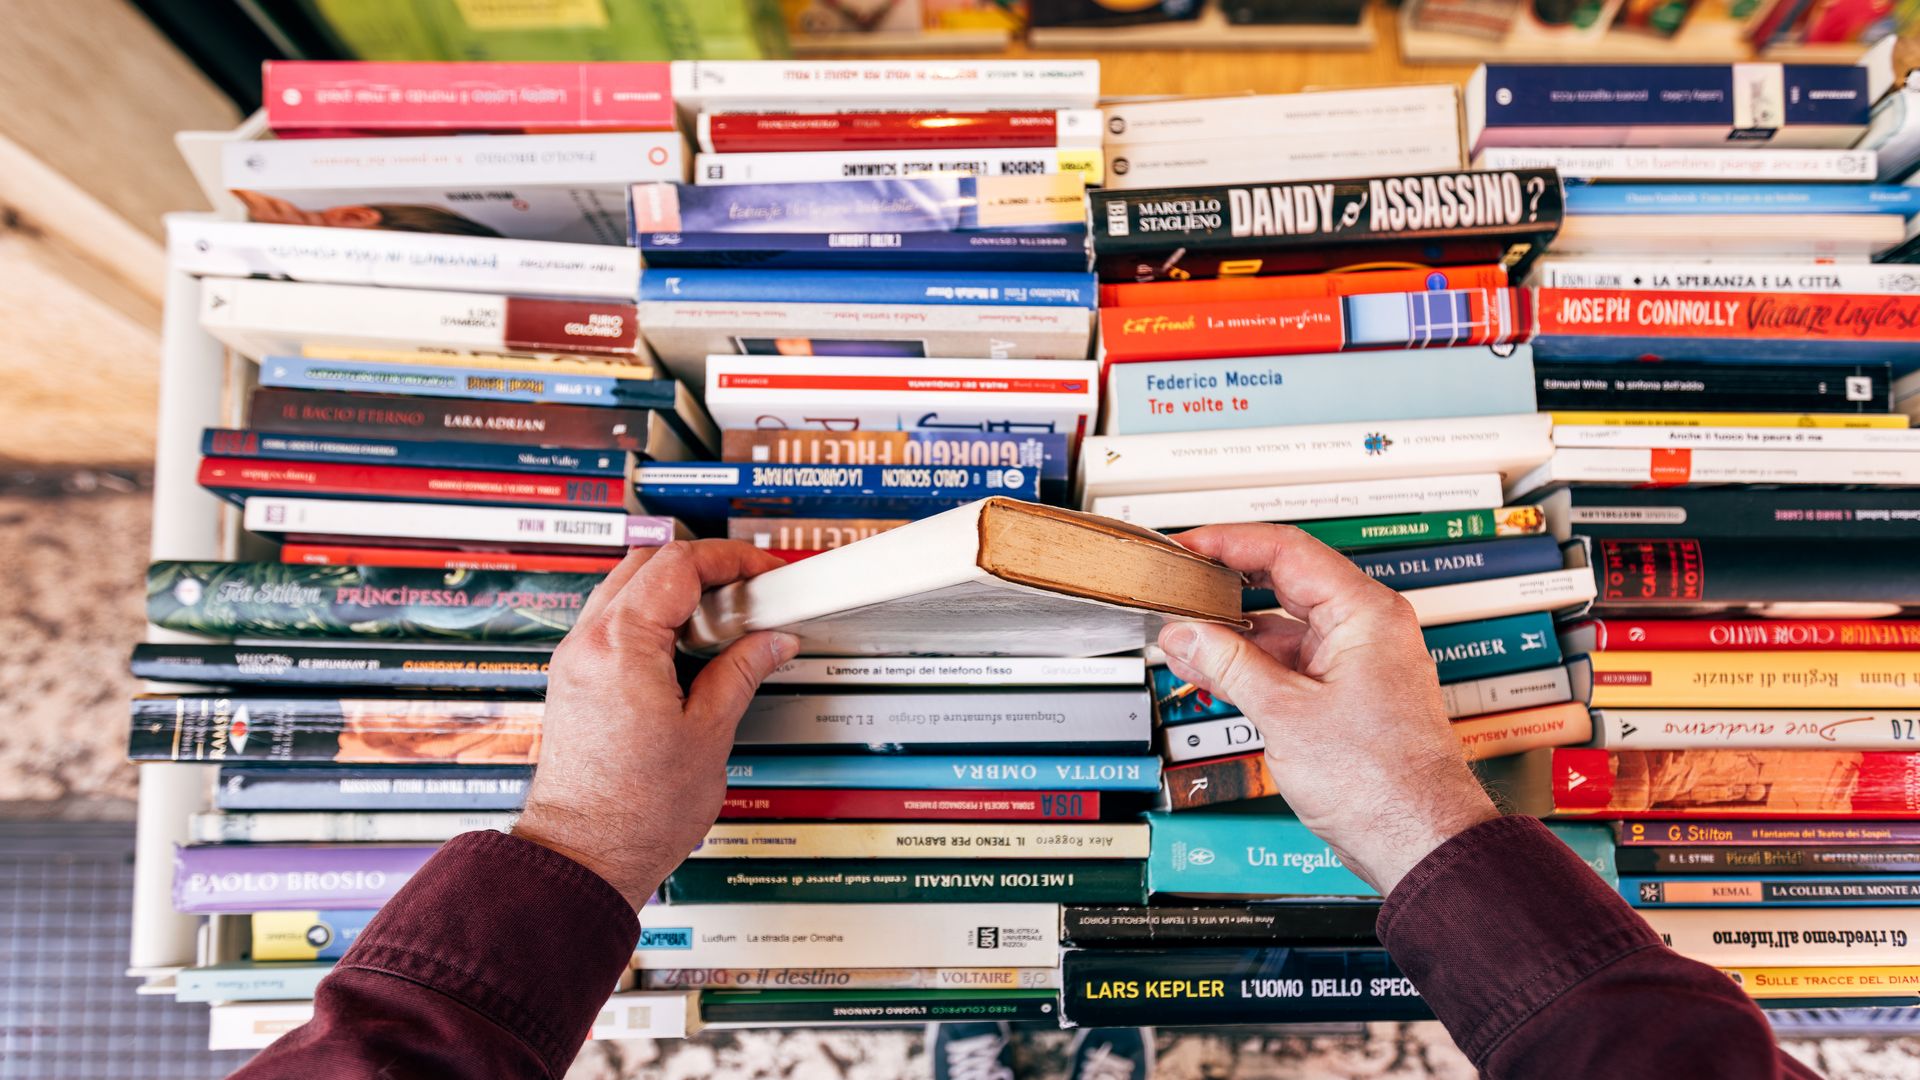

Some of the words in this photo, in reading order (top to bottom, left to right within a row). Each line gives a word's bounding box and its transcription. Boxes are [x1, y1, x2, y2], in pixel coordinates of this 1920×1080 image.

[1138, 198, 1221, 215] MARCELLO
[1228, 184, 1335, 237] DANDY
[1369, 172, 1523, 231] ASSASSINO
[1527, 177, 1546, 222] ?
[1139, 213, 1222, 233] STAGLIENO
[1653, 275, 1671, 287] LA
[1676, 275, 1756, 288] SPERANZA
[1776, 275, 1792, 288] LA
[1799, 273, 1842, 289] CITTÀ
[1003, 285, 1028, 302] Fini
[1028, 286, 1080, 303] Massimo
[1207, 316, 1224, 329] La
[1227, 313, 1276, 328] musica
[1279, 309, 1331, 329] perfetta
[1556, 296, 1631, 324] JOSEPH
[1637, 299, 1740, 327] CONNOLLY
[1746, 296, 1830, 334] Vacanze
[1123, 317, 1149, 336] Kat
[1150, 315, 1196, 334] French
[907, 380, 961, 390] CINQUANTA
[980, 381, 1009, 390] PAURA
[1147, 370, 1218, 391] Federico
[1226, 368, 1283, 388] Moccia
[1544, 378, 1580, 390] Edmund
[1581, 379, 1608, 391] White
[1626, 379, 1661, 391] sinfonia
[1663, 380, 1705, 392] dell'addio
[1149, 398, 1174, 415] Tre
[1182, 396, 1224, 413] volte
[1233, 396, 1249, 411] te
[444, 413, 483, 429] LARA
[485, 415, 546, 433] ADRIAN
[1669, 431, 1702, 441] Anche
[1762, 433, 1790, 444] paura
[518, 452, 549, 465] Silicon
[550, 453, 580, 468] Valley
[752, 468, 783, 487] RAME
[792, 468, 848, 487] CARROZZA
[848, 468, 863, 487] LA
[881, 469, 932, 488] SGORLON
[934, 469, 969, 488] CARLO
[565, 480, 609, 504] USA
[553, 518, 613, 536] BALLESTRA
[1361, 522, 1429, 539] FITZGERALD
[1447, 519, 1465, 538] 73
[1400, 560, 1432, 574] DEL
[1435, 553, 1485, 571] PADRE
[1684, 542, 1698, 599] NOTTE
[217, 580, 254, 602] Tea
[255, 582, 322, 604] Stilton
[336, 584, 468, 606] PRINCIPESSA
[497, 590, 582, 609] FORESTE
[826, 665, 871, 677] L'amore
[872, 665, 882, 676] ai
[884, 665, 917, 679] tempi
[918, 665, 936, 676] del
[937, 665, 983, 676] telefono
[984, 665, 1013, 676] fisso
[1693, 671, 1755, 687] astuzie
[1760, 671, 1776, 687] di
[1782, 670, 1839, 688] Regina
[1860, 673, 1905, 687] Dunn
[815, 714, 852, 725] James
[855, 714, 863, 724] L
[865, 713, 874, 724] E
[888, 711, 927, 725] Grigio
[928, 711, 941, 724] di
[942, 711, 1002, 725] sfumature
[1004, 710, 1066, 724] Cinquanta
[210, 698, 230, 761] RAMSES
[1462, 727, 1508, 745] ARSLAN
[1508, 720, 1565, 739] ANTONIA
[1662, 720, 1776, 742] andiamo
[952, 764, 1037, 780] OMBRA
[1055, 764, 1140, 780] RIOTTA
[1041, 794, 1083, 817] USA
[1632, 823, 1645, 841] 10
[1668, 826, 1684, 842] G.
[1687, 826, 1733, 841] Stilton
[1759, 829, 1801, 839] fantasma
[1818, 829, 1846, 840] Teatro
[896, 836, 947, 847] BABYLON
[951, 836, 971, 847] PER
[976, 836, 1012, 847] TRENO
[1016, 836, 1025, 847] IL
[1037, 835, 1083, 847] Roggero
[1089, 836, 1113, 847] Alex
[1246, 847, 1278, 866] Un
[1282, 846, 1343, 874] regalo
[1687, 853, 1715, 864] STINE
[1726, 851, 1762, 866] Piccoli
[191, 873, 279, 894] PAOLO
[287, 870, 386, 891] BROSIO
[726, 873, 791, 886] sessuologia
[792, 874, 804, 886] di
[806, 873, 843, 884] pavese
[845, 875, 875, 885] studi
[877, 875, 907, 884] centro
[914, 874, 995, 886] NATURALI
[1000, 874, 1064, 886] METODI
[1711, 886, 1753, 897] KEMAL
[1772, 886, 1786, 897] LA
[1789, 886, 1841, 897] COLLERA
[1842, 886, 1866, 897] DEL
[1868, 885, 1908, 897] MONTE
[1079, 916, 1110, 925] POIROT
[1111, 916, 1148, 925] HERCULE
[701, 933, 737, 944] Ludlum
[746, 933, 758, 944] La
[759, 933, 790, 944] strada
[790, 935, 808, 946] per
[809, 933, 844, 944] Omaha
[1712, 929, 1799, 947] all'inferno
[1802, 930, 1887, 947] rivedremo
[1889, 930, 1908, 947] Ci
[736, 972, 750, 986] o
[755, 969, 768, 986] il
[773, 968, 850, 987] destino
[941, 971, 1014, 985] VOLTAIRE
[1756, 974, 1799, 987] SULLE
[1803, 974, 1855, 986] TRACCE
[1859, 974, 1885, 986] DEL
[1085, 981, 1140, 999] LARS
[1144, 980, 1225, 998] KEPLER
[1240, 979, 1304, 998] L'UOMO
[1310, 979, 1363, 998] DELLO
[833, 1005, 884, 1015] CANNONE
[885, 1004, 928, 1015] L'UOMO
[931, 1004, 986, 1014] COLAPRICO
[989, 1004, 1017, 1013] PIERO
